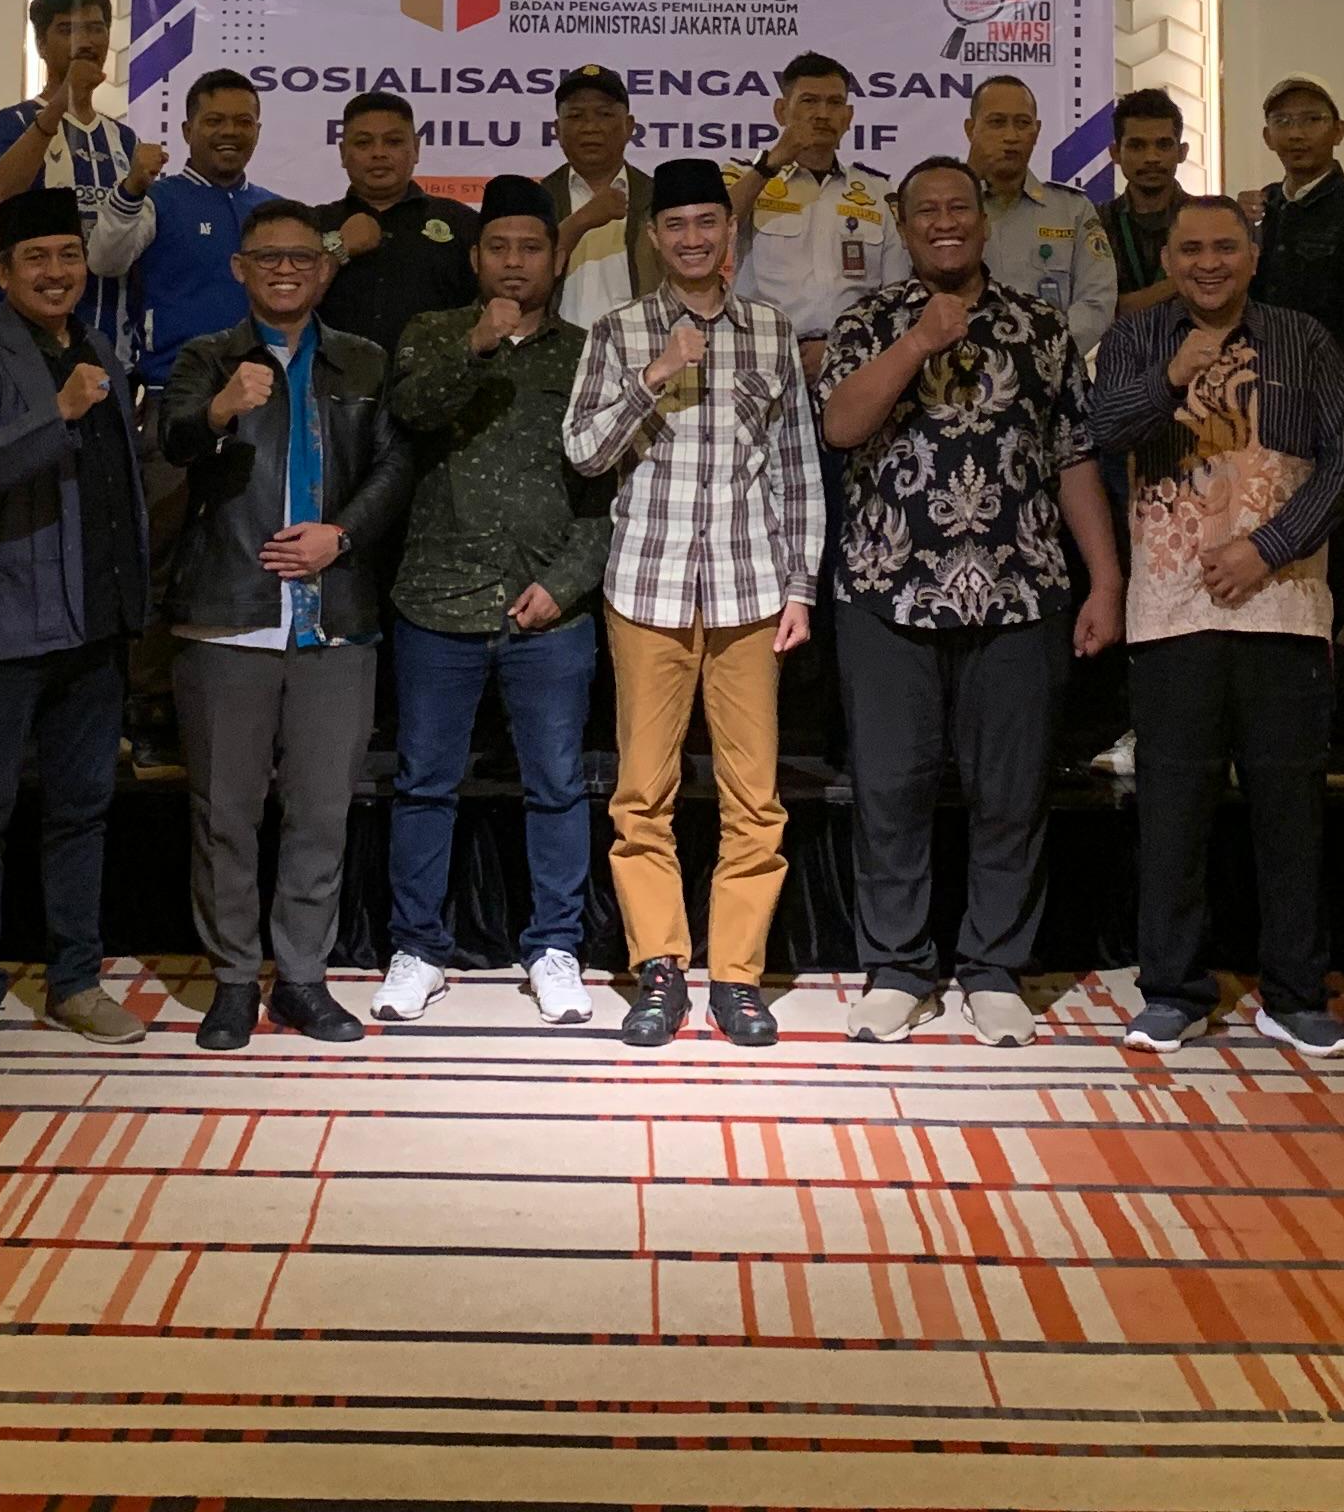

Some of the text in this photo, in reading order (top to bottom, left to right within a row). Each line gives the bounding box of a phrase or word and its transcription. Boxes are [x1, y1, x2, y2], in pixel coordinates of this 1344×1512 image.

[510, 1, 798, 13] BADAN PENGAWAS PEMILIHAN UMUM
[510, 14, 798, 36] KOTA ADMINISTRASI JAKARTA UTARA
[988, 22, 1050, 41] AWASI
[964, 43, 1050, 62] BERSAMA
[627, 68, 973, 97] ENGAASAN
[327, 119, 898, 150] PILU PRTISIPIF
